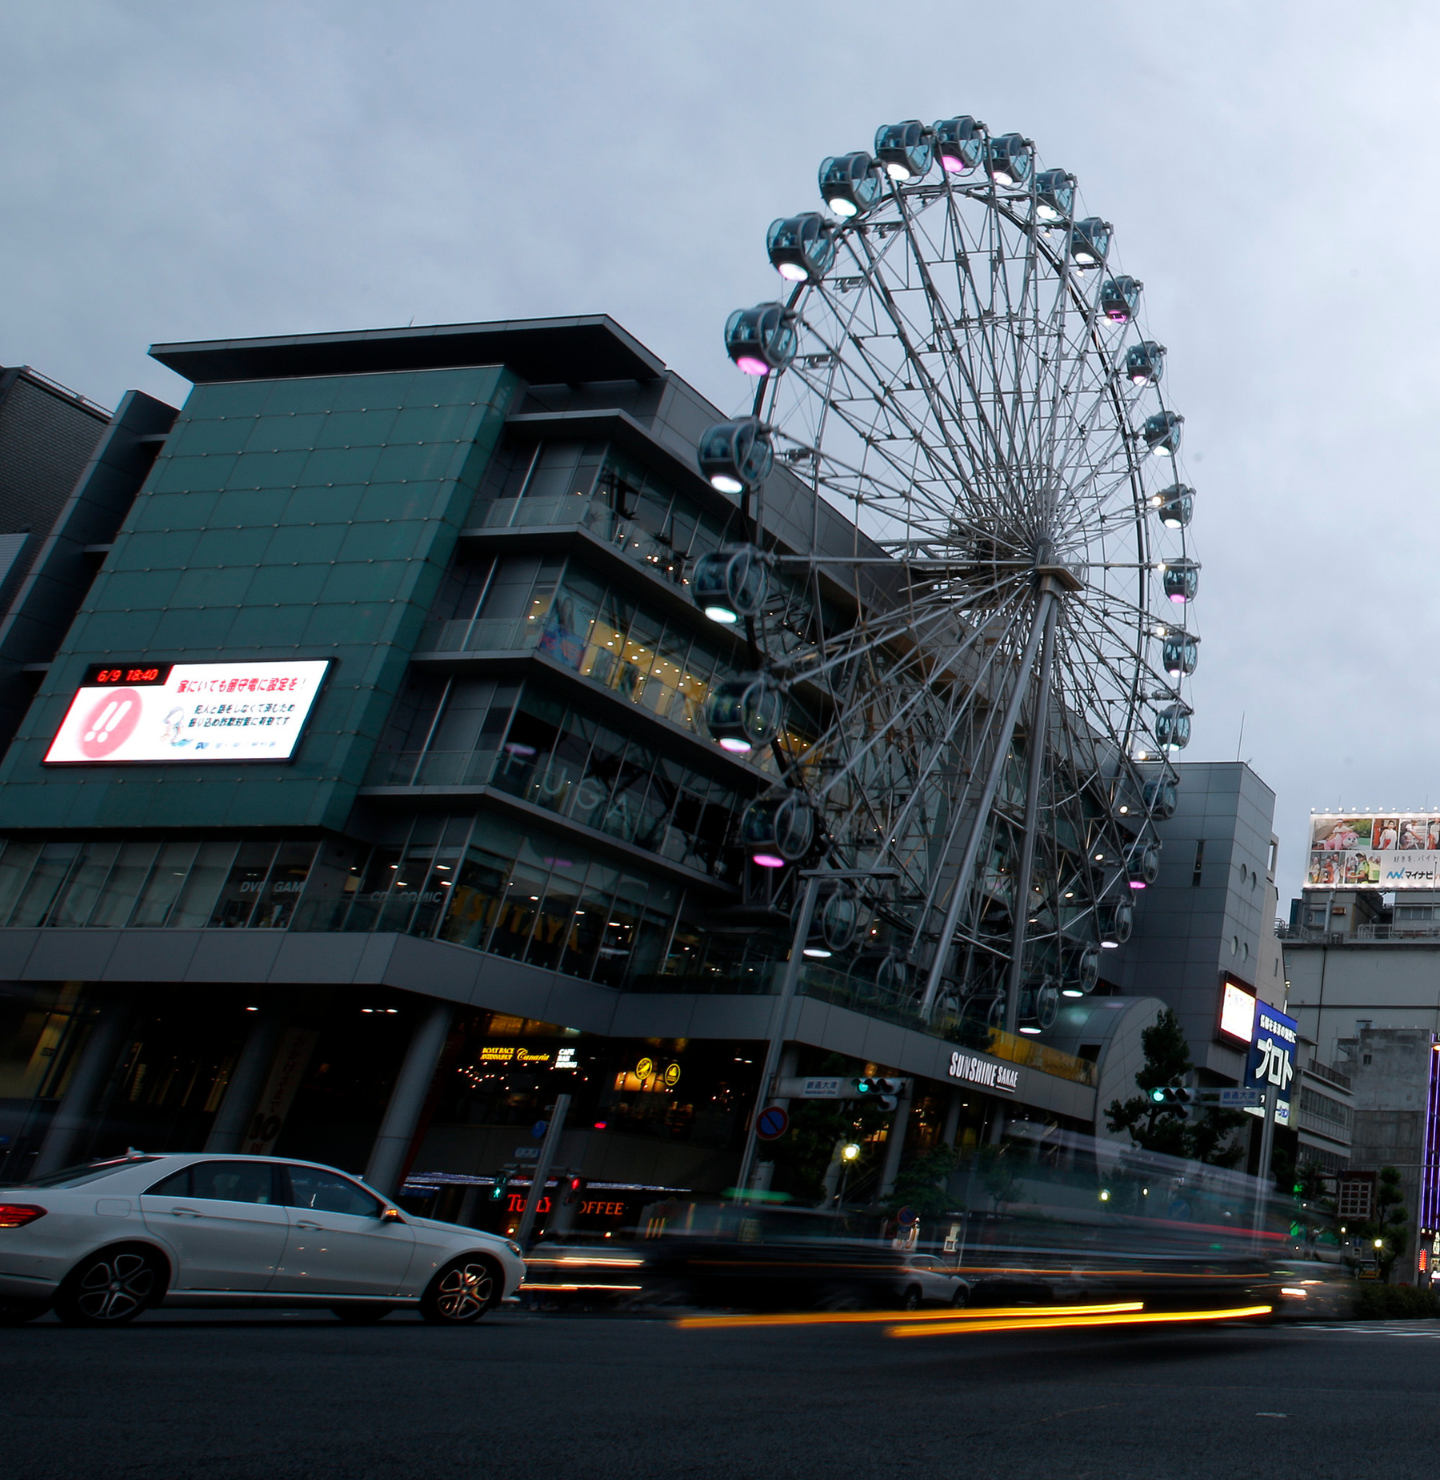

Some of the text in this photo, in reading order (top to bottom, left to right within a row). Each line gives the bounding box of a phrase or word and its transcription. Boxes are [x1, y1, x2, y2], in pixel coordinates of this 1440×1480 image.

[97, 668, 159, 682] 6/9 18:40
[451, 884, 583, 955] TSUTAYA
[949, 1051, 1019, 1087] SUNSHINE SAKAE
[1255, 1037, 1294, 1091] プロト
[250, 1112, 282, 1142] 10
